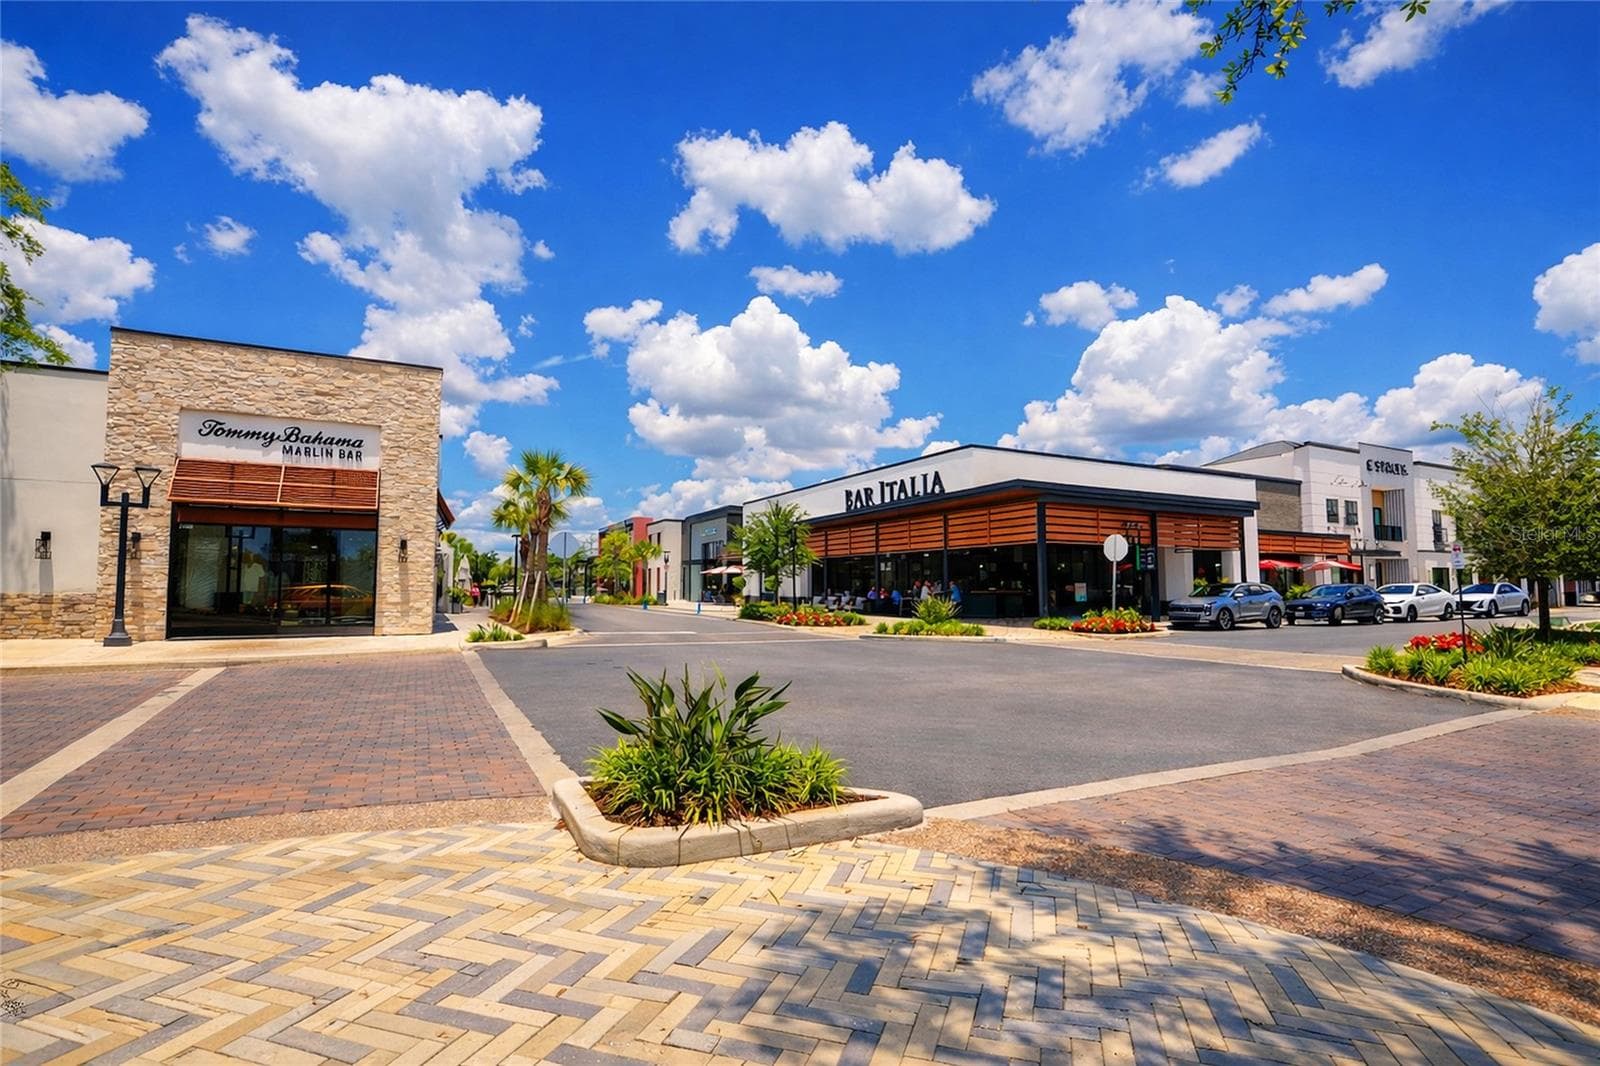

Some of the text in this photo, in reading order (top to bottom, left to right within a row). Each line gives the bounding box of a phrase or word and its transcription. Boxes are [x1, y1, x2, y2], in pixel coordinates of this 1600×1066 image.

[199, 419, 364, 448] Tommy Bahama
[282, 445, 363, 462] MARLIN BAR
[845, 470, 945, 511] BAR ITALIA
